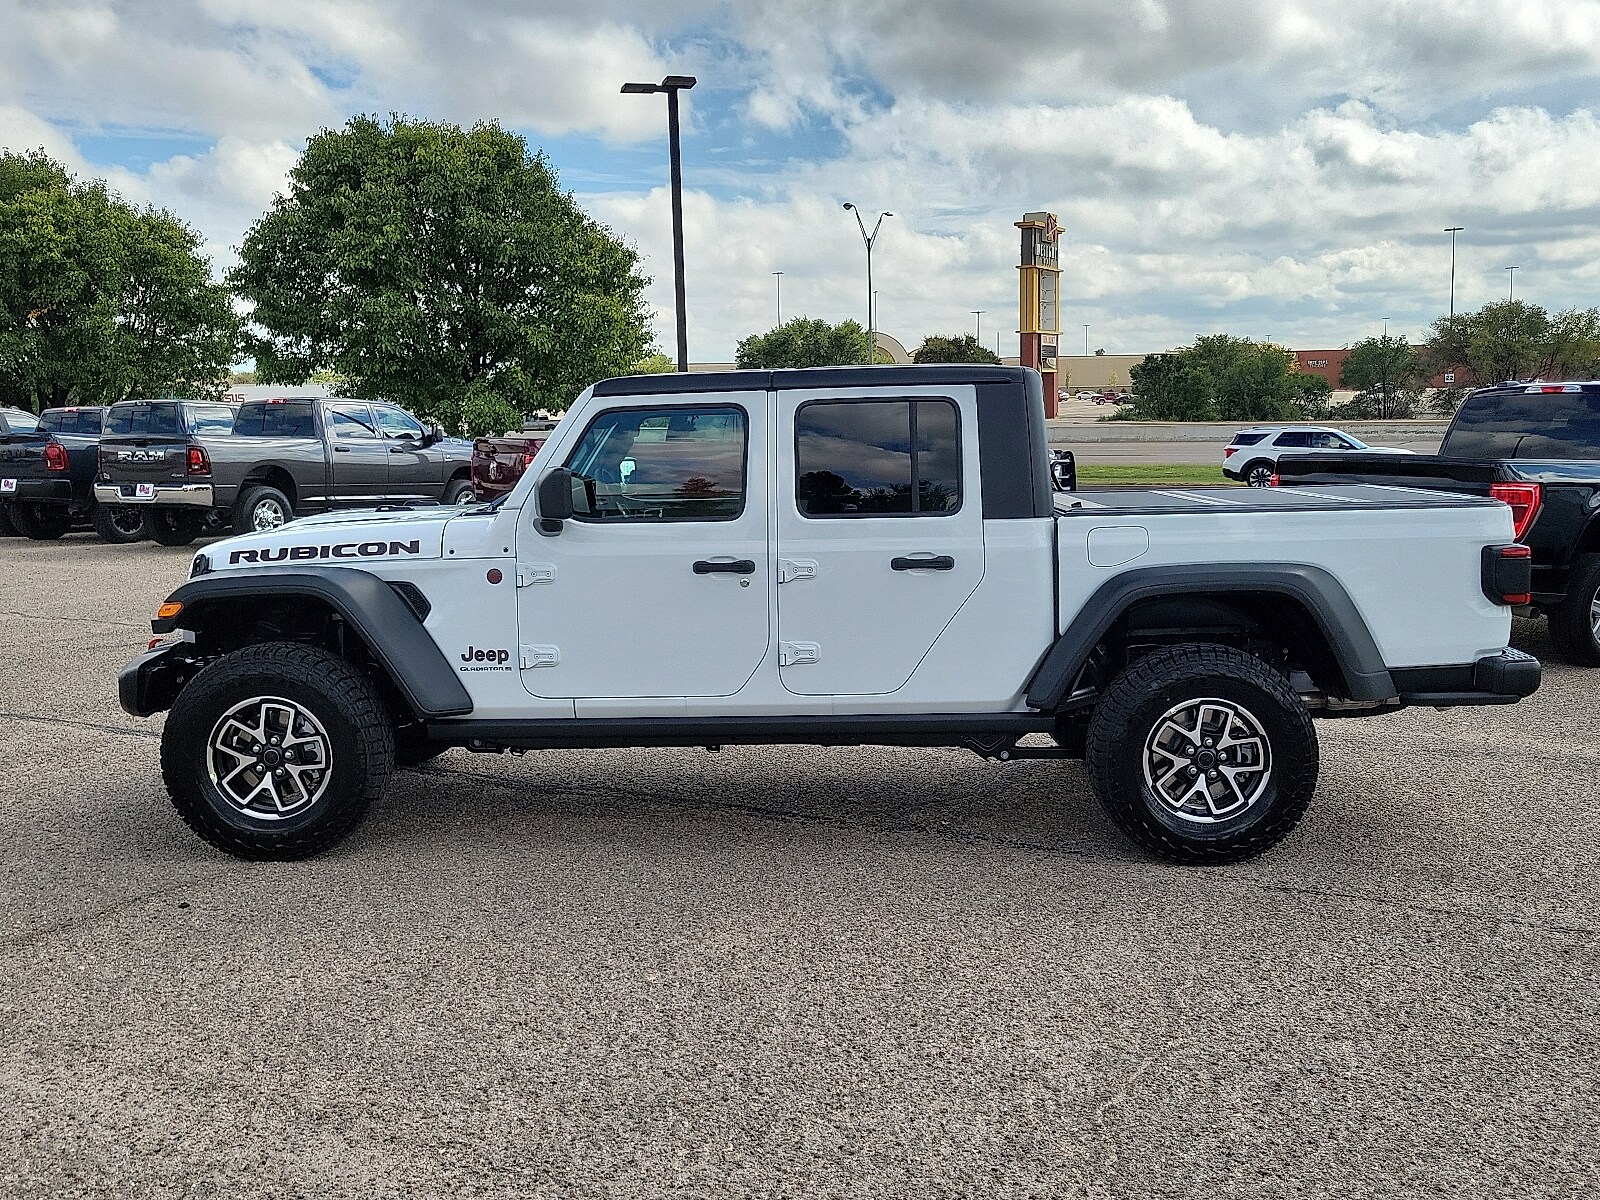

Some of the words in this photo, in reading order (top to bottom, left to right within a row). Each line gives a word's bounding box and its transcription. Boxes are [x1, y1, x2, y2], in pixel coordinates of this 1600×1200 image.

[117, 450, 166, 462] RAM
[229, 540, 421, 565] RUBICON
[460, 646, 510, 665] Jeep
